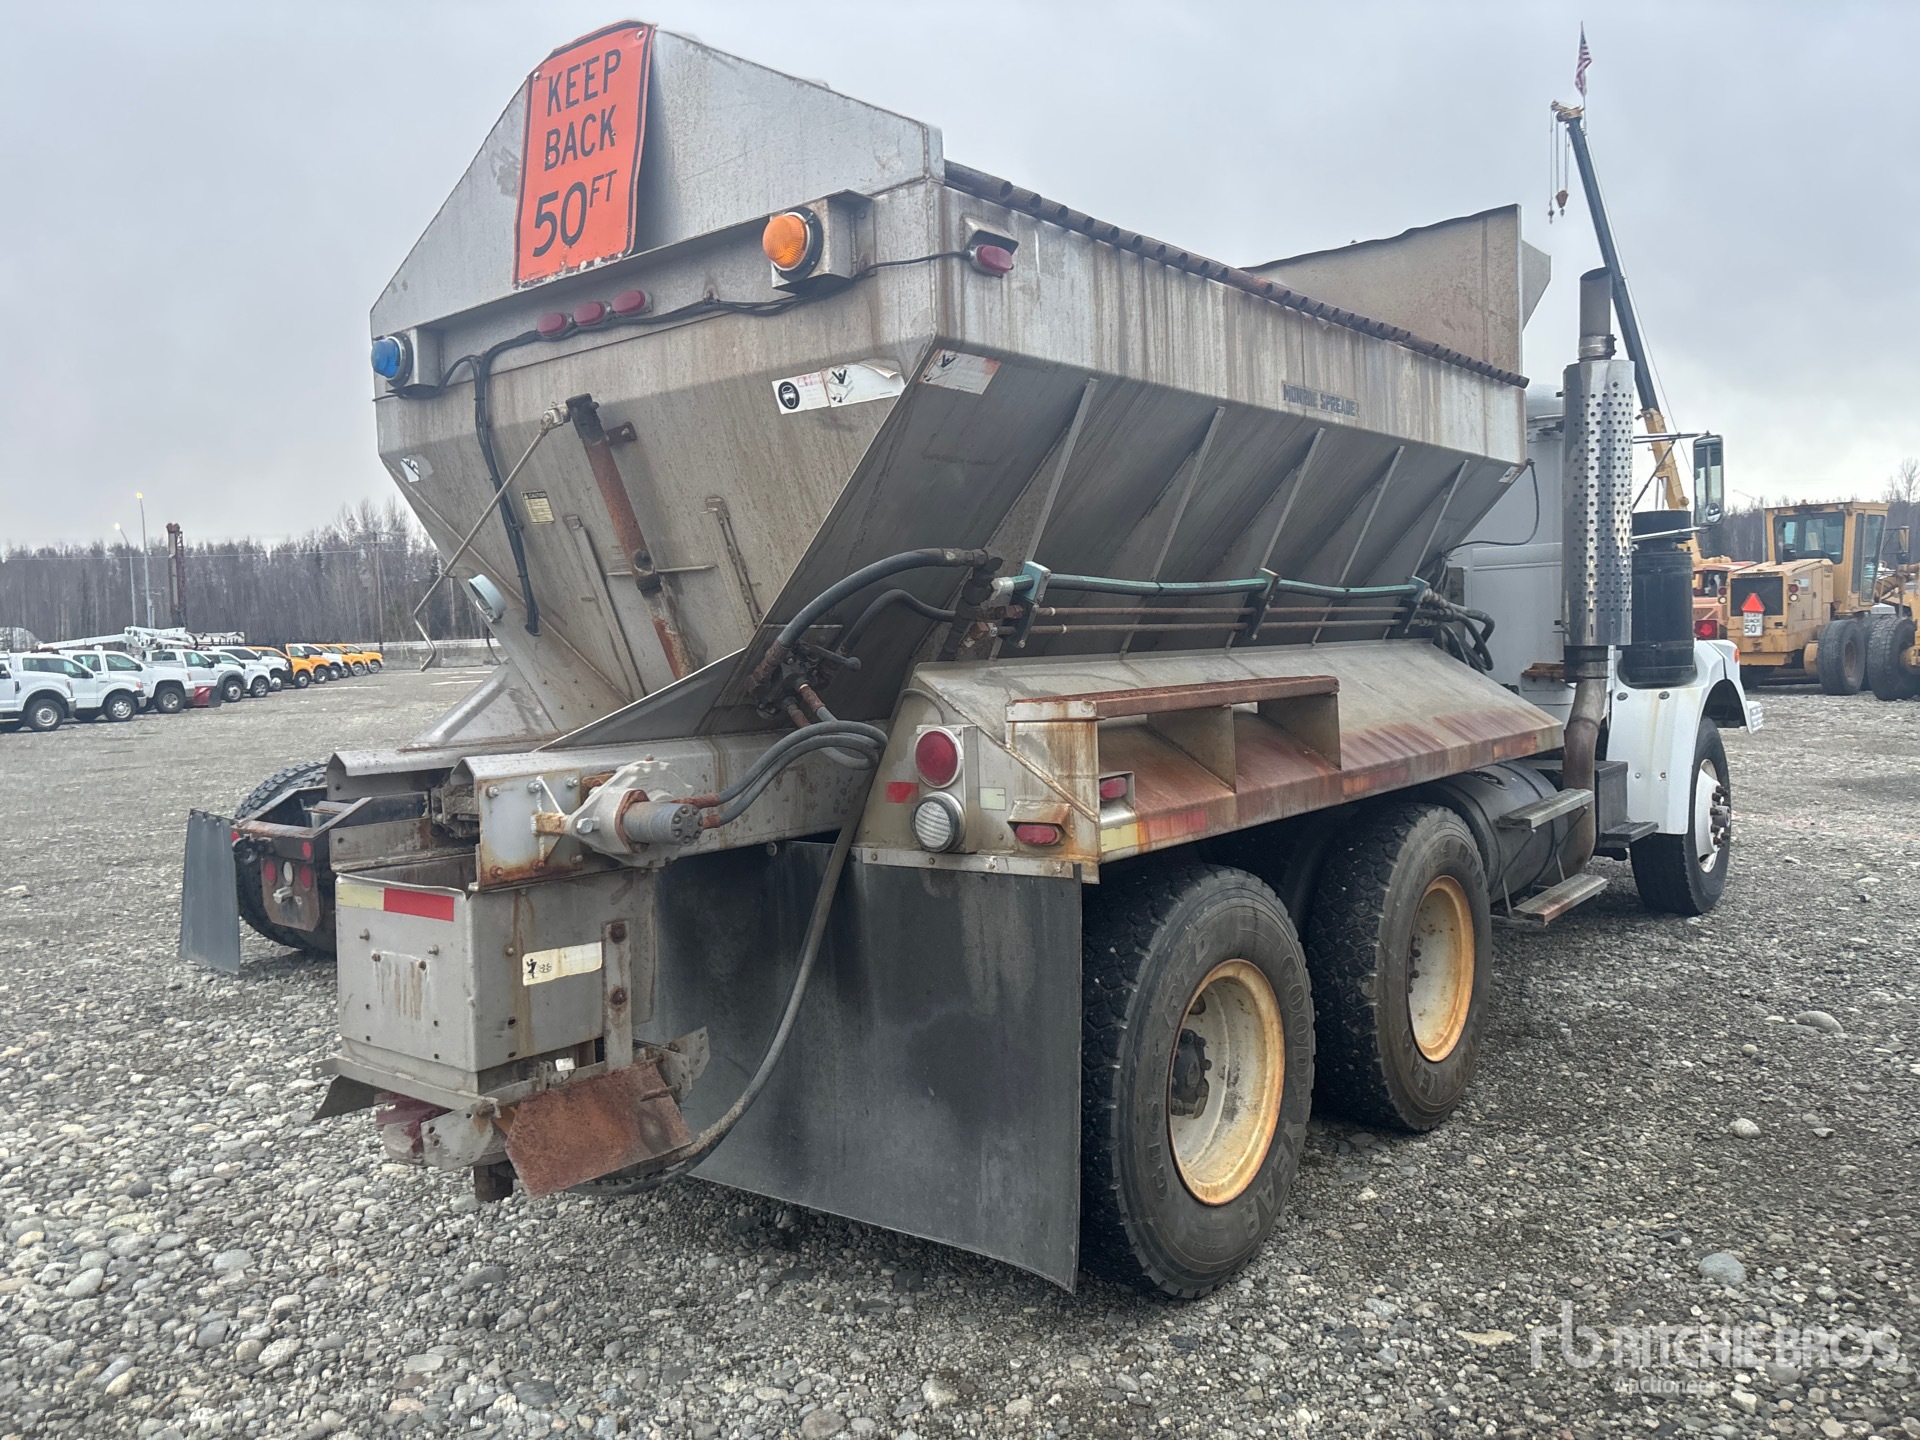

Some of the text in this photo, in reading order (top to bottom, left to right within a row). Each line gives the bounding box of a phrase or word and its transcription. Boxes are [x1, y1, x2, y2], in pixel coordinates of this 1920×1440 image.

[547, 48, 622, 117] KEEP
[544, 104, 617, 172] BACK
[1744, 624, 1757, 634] 50
